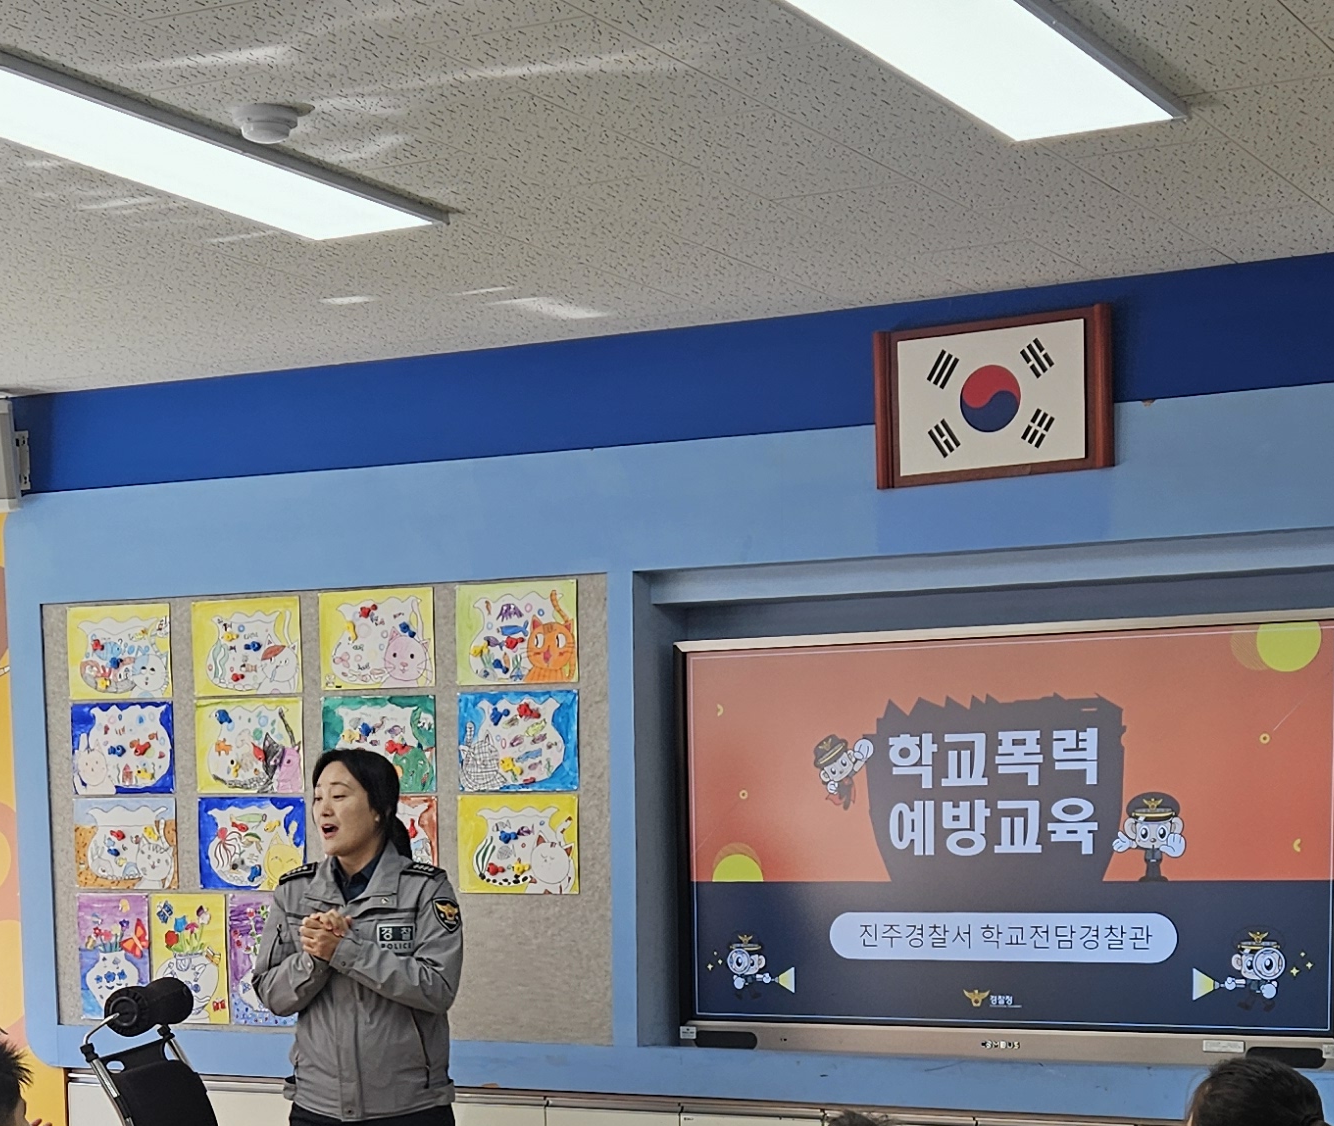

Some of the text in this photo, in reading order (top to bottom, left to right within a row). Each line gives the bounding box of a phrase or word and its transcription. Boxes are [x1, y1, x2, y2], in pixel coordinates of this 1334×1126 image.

[888, 727, 1098, 789] 학교폭력
[889, 797, 1098, 856] 예방교육
[381, 942, 412, 950] POLICE
[859, 923, 1153, 950] 진주경찰서 학교전담경찰관
[989, 995, 1013, 1006] 경찰청
